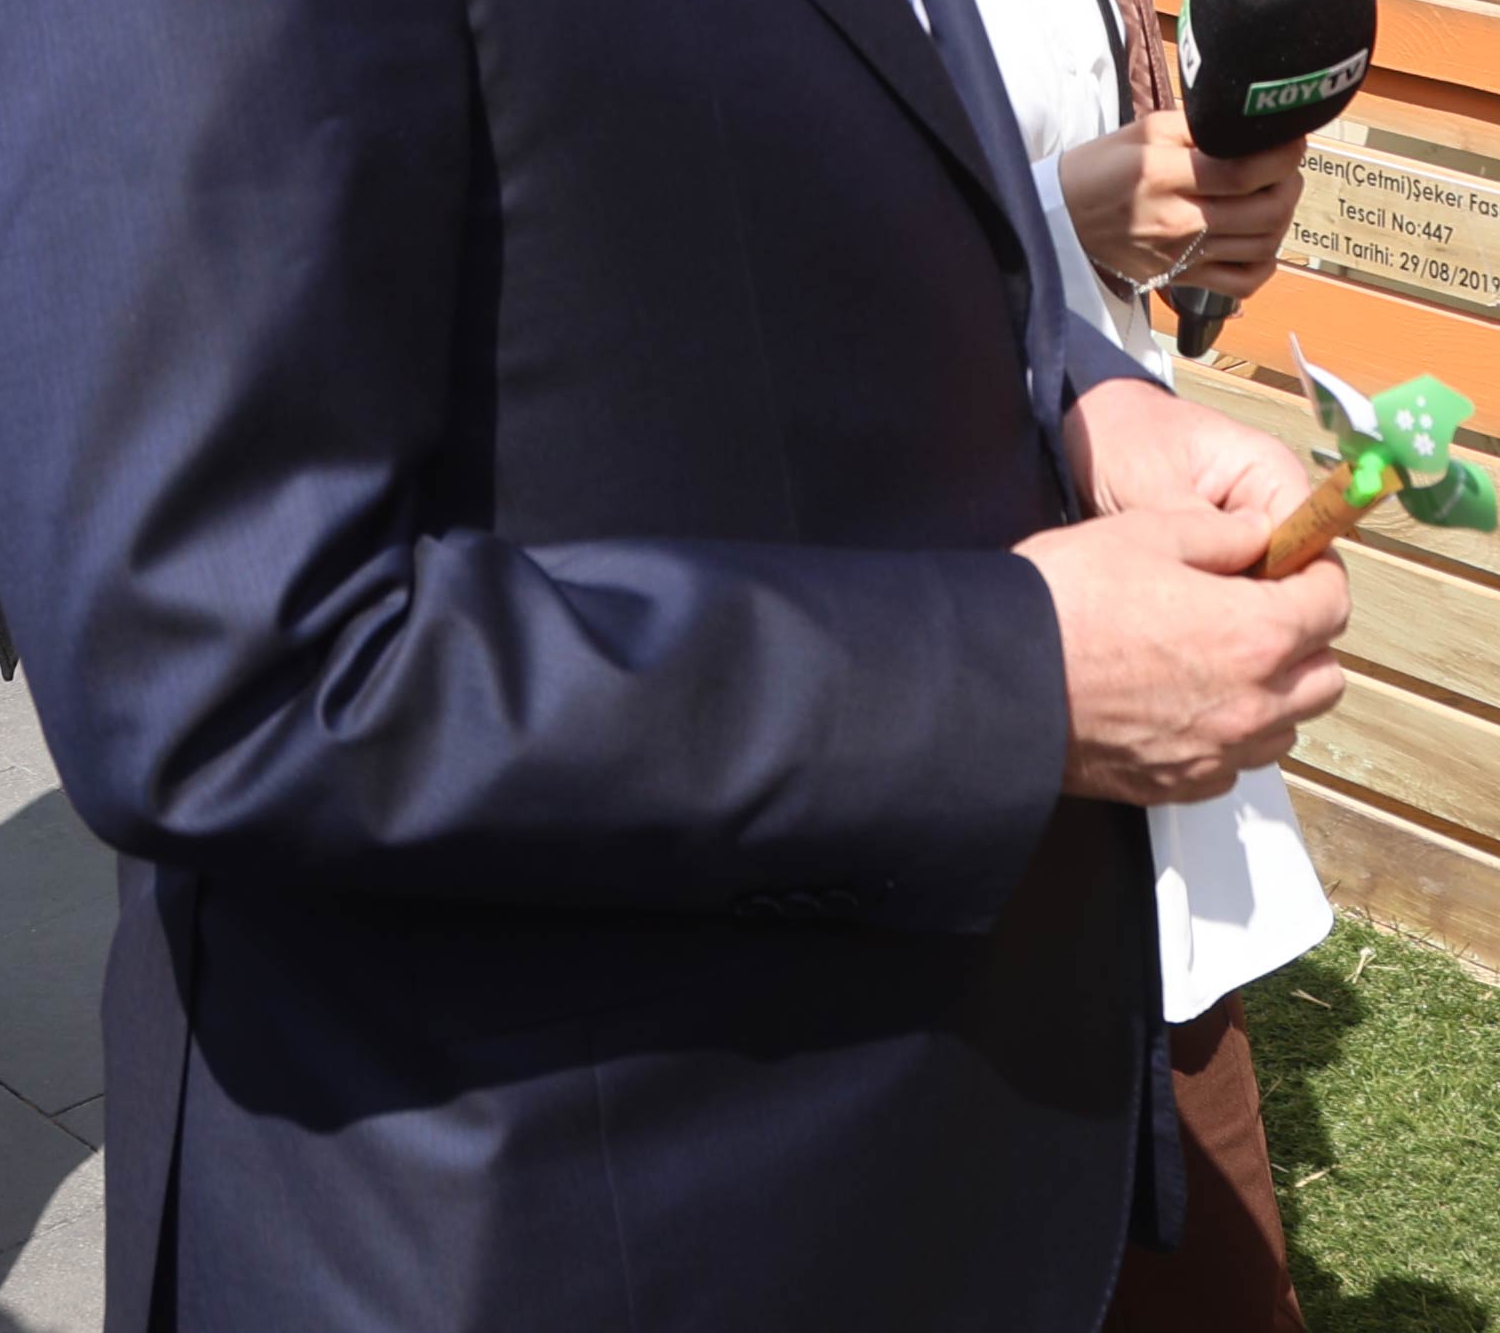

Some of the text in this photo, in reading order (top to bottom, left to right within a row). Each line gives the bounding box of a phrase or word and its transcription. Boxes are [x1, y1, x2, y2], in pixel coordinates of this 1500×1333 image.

[1338, 198, 1454, 245] Tescil No:447
[1293, 221, 1500, 294] Tescil Tarihi: 29/08/2019
